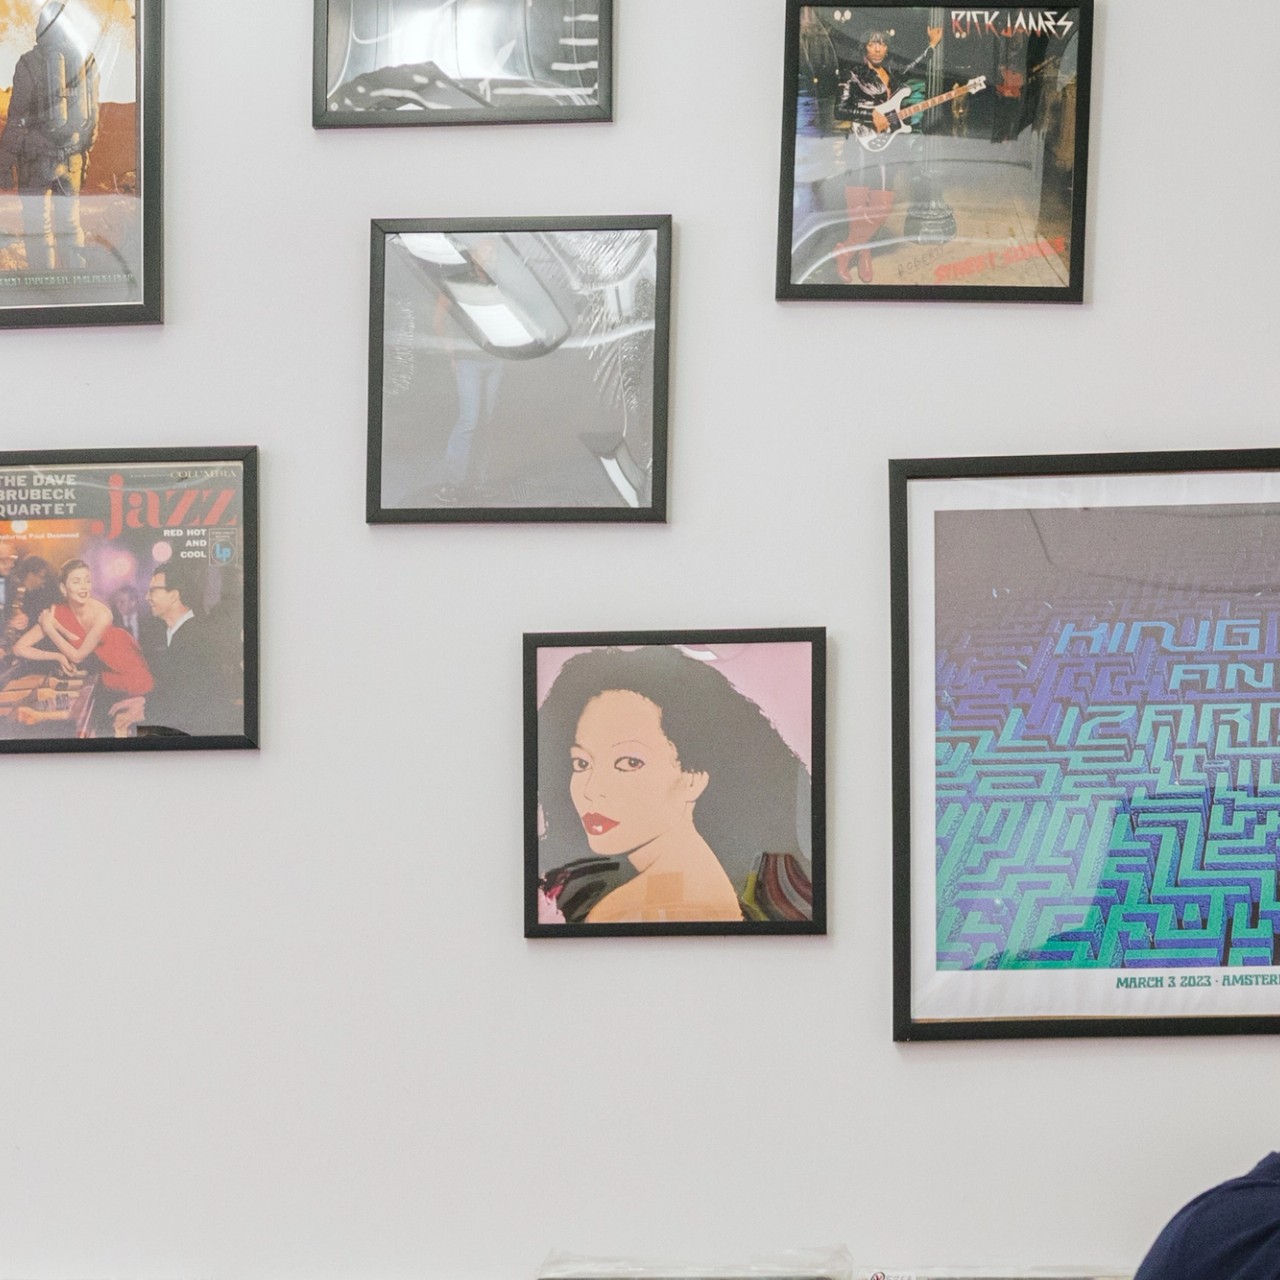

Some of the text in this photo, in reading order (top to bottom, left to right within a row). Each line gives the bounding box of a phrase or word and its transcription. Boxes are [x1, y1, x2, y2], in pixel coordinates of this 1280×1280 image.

[951, 10, 1073, 39] RICK JAMES
[32, 474, 77, 487] DAVE
[169, 469, 238, 480] COLUMBIA
[90, 472, 238, 541] jazz
[163, 529, 184, 537] RED
[186, 528, 207, 537] HOT
[186, 539, 207, 547] AND
[180, 550, 207, 559] COOL
[1116, 976, 1164, 989] MARCH
[1168, 976, 1177, 988] 3
[1180, 975, 1212, 987] 2023
